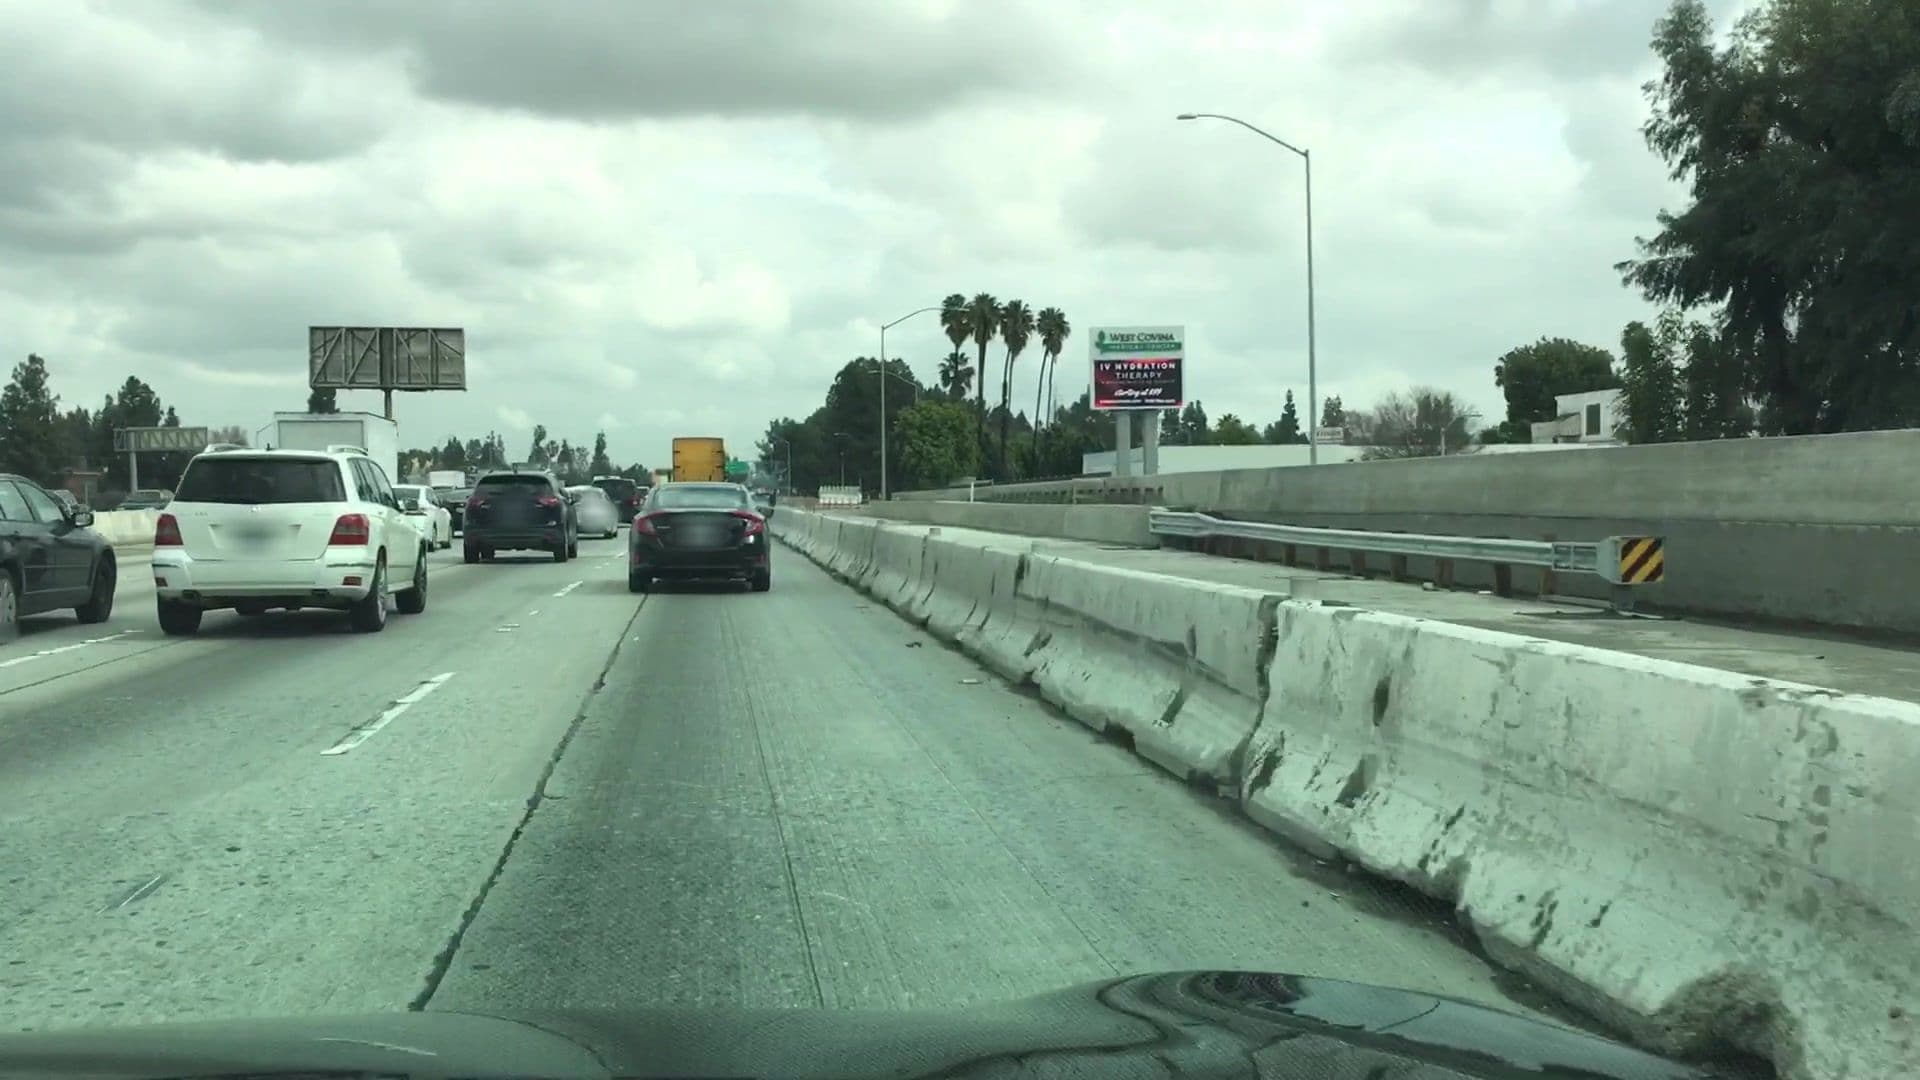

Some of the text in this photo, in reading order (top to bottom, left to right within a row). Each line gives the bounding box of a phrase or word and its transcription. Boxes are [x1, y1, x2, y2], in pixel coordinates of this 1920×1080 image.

[1110, 333, 1175, 342] WEST COVINA
[1100, 362, 1176, 371] IV HYDRATION
[1115, 372, 1162, 380] THERAPY
